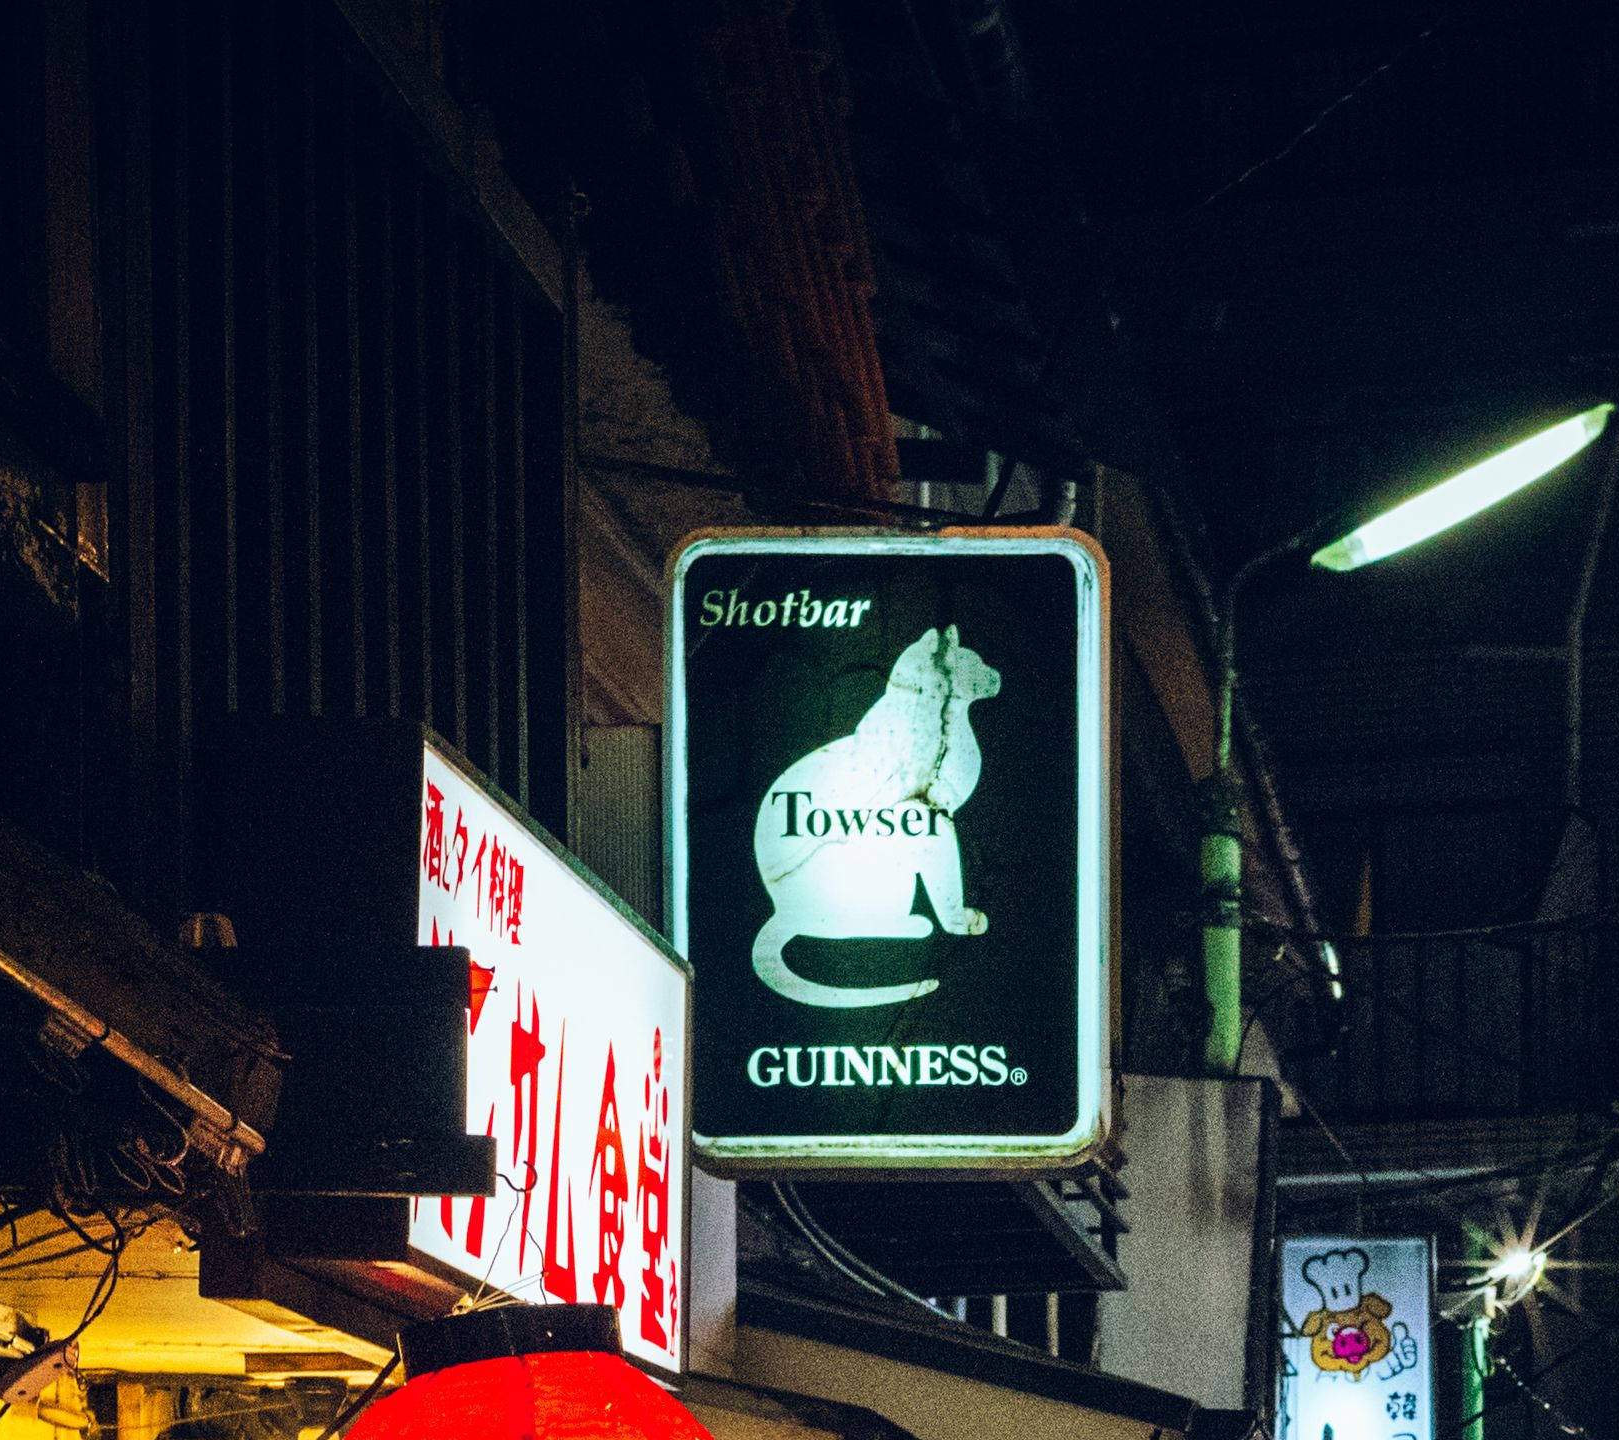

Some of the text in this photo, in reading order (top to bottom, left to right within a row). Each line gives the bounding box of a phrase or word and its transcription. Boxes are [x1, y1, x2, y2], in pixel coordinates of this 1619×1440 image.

[700, 589, 871, 630] Shotbar
[424, 778, 524, 945] 酒とタイ料理
[772, 791, 951, 839] Towser
[412, 917, 671, 1350] ンサム食堂
